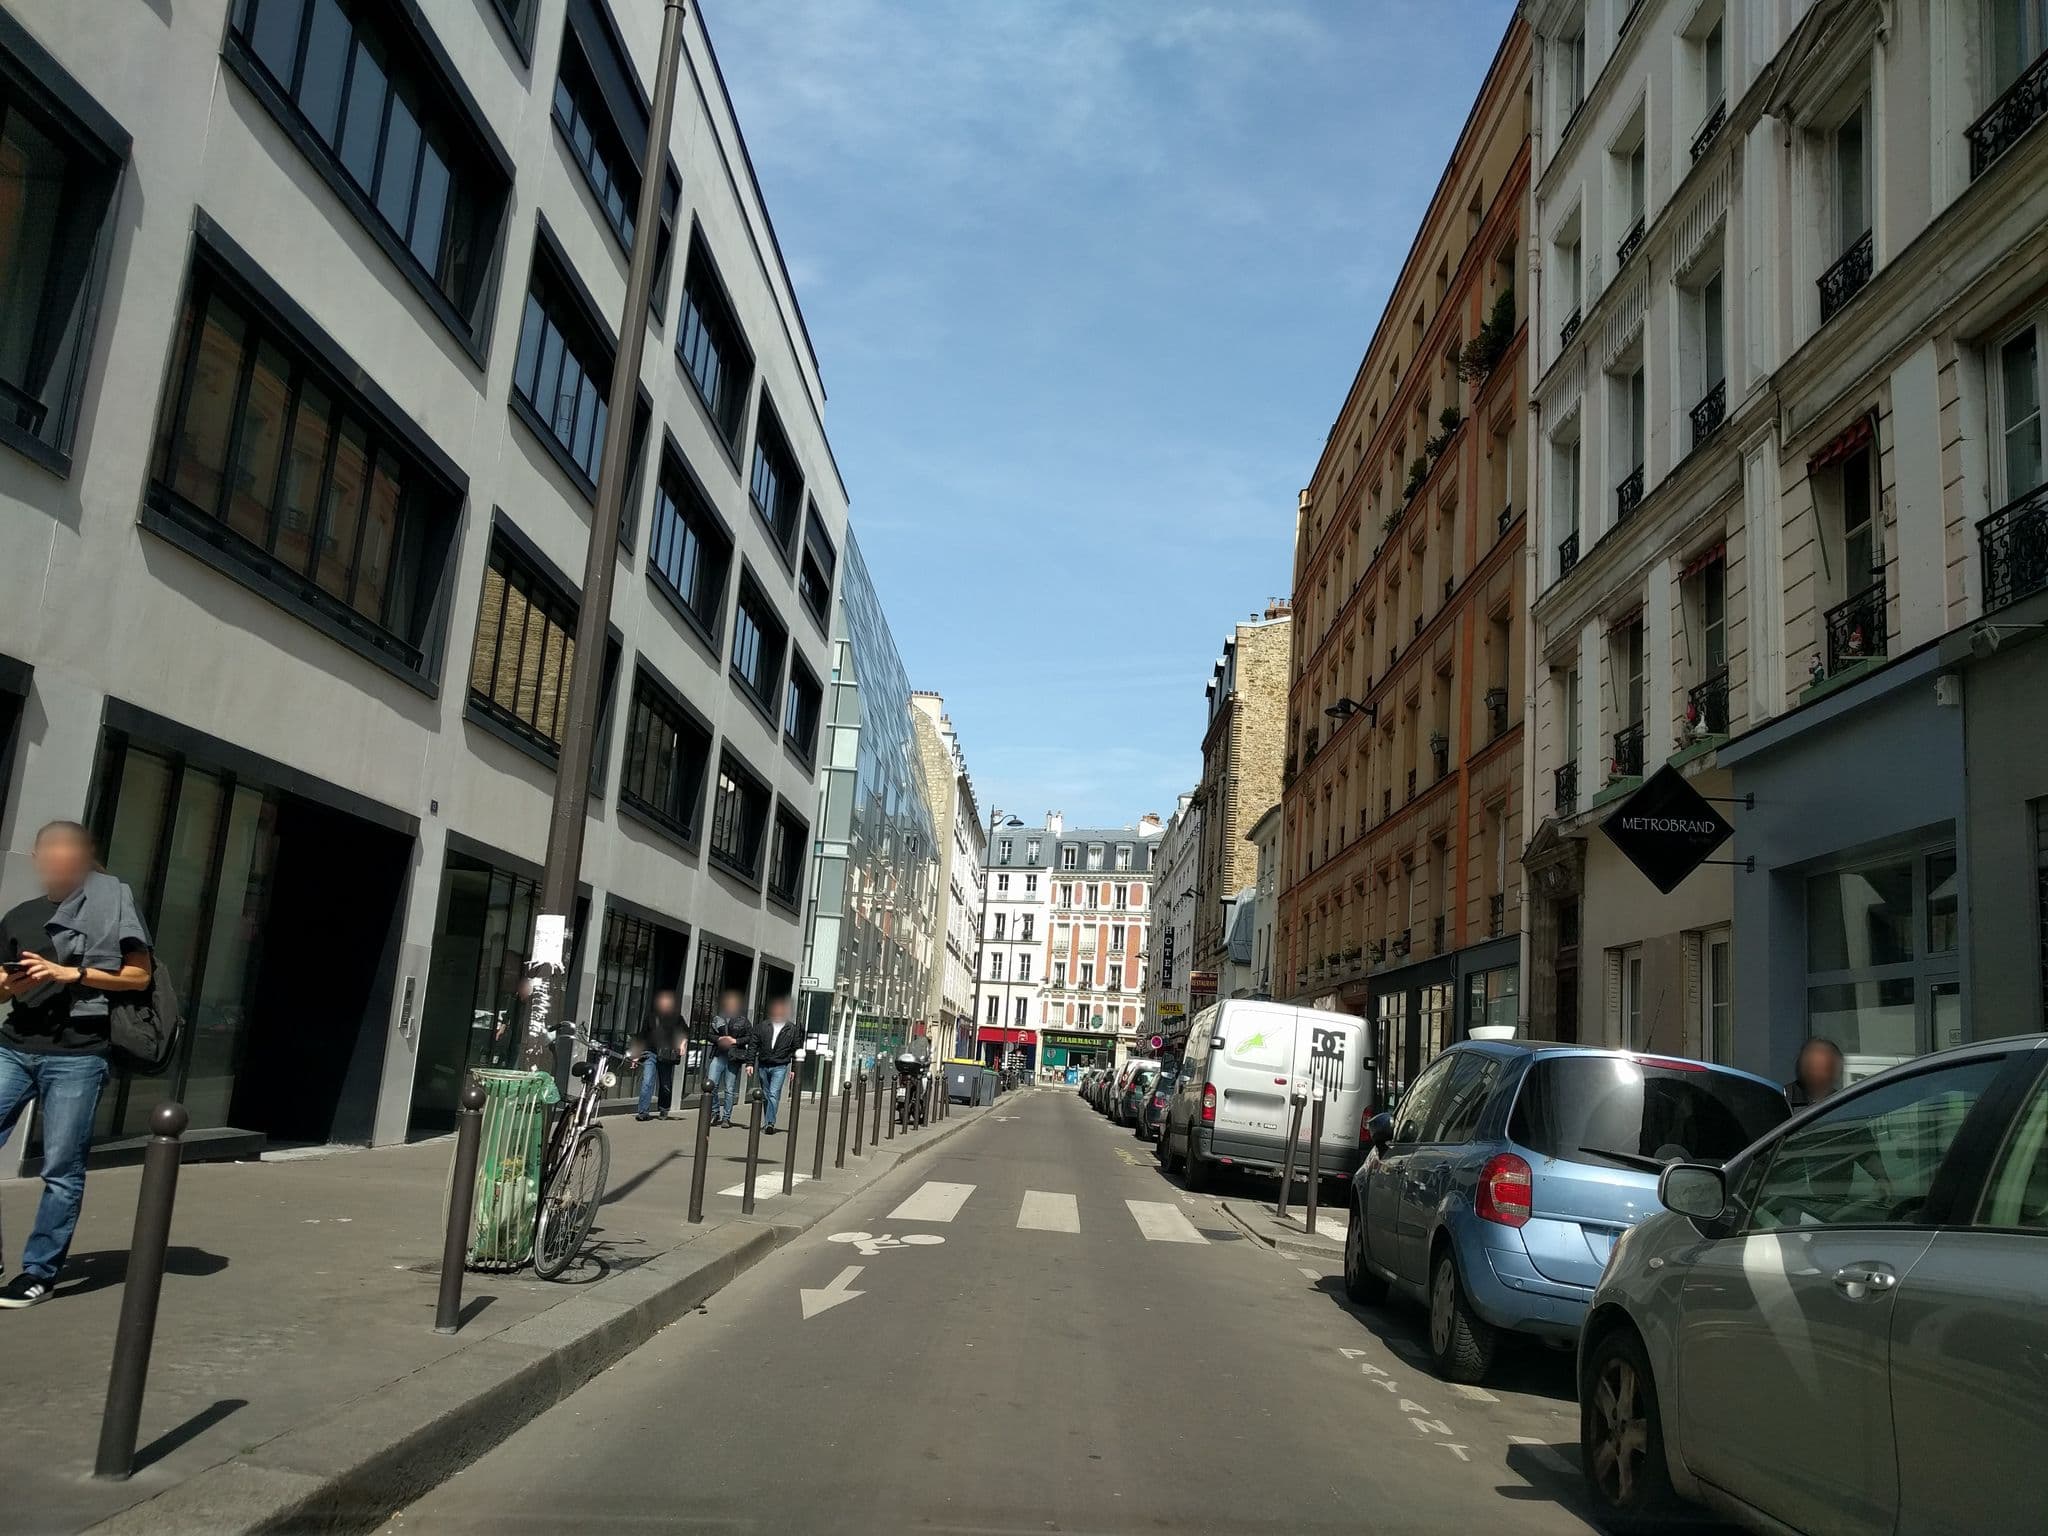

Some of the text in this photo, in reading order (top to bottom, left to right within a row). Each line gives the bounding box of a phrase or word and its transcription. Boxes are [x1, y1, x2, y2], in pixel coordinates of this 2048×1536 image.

[1621, 817, 1715, 834] METROBRAND
[1163, 926, 1173, 978] HOTEL
[1160, 1004, 1181, 1012] HOTEL
[1056, 1036, 1102, 1046] PHARMACIE
[1338, 1347, 1470, 1461] PAYANT
